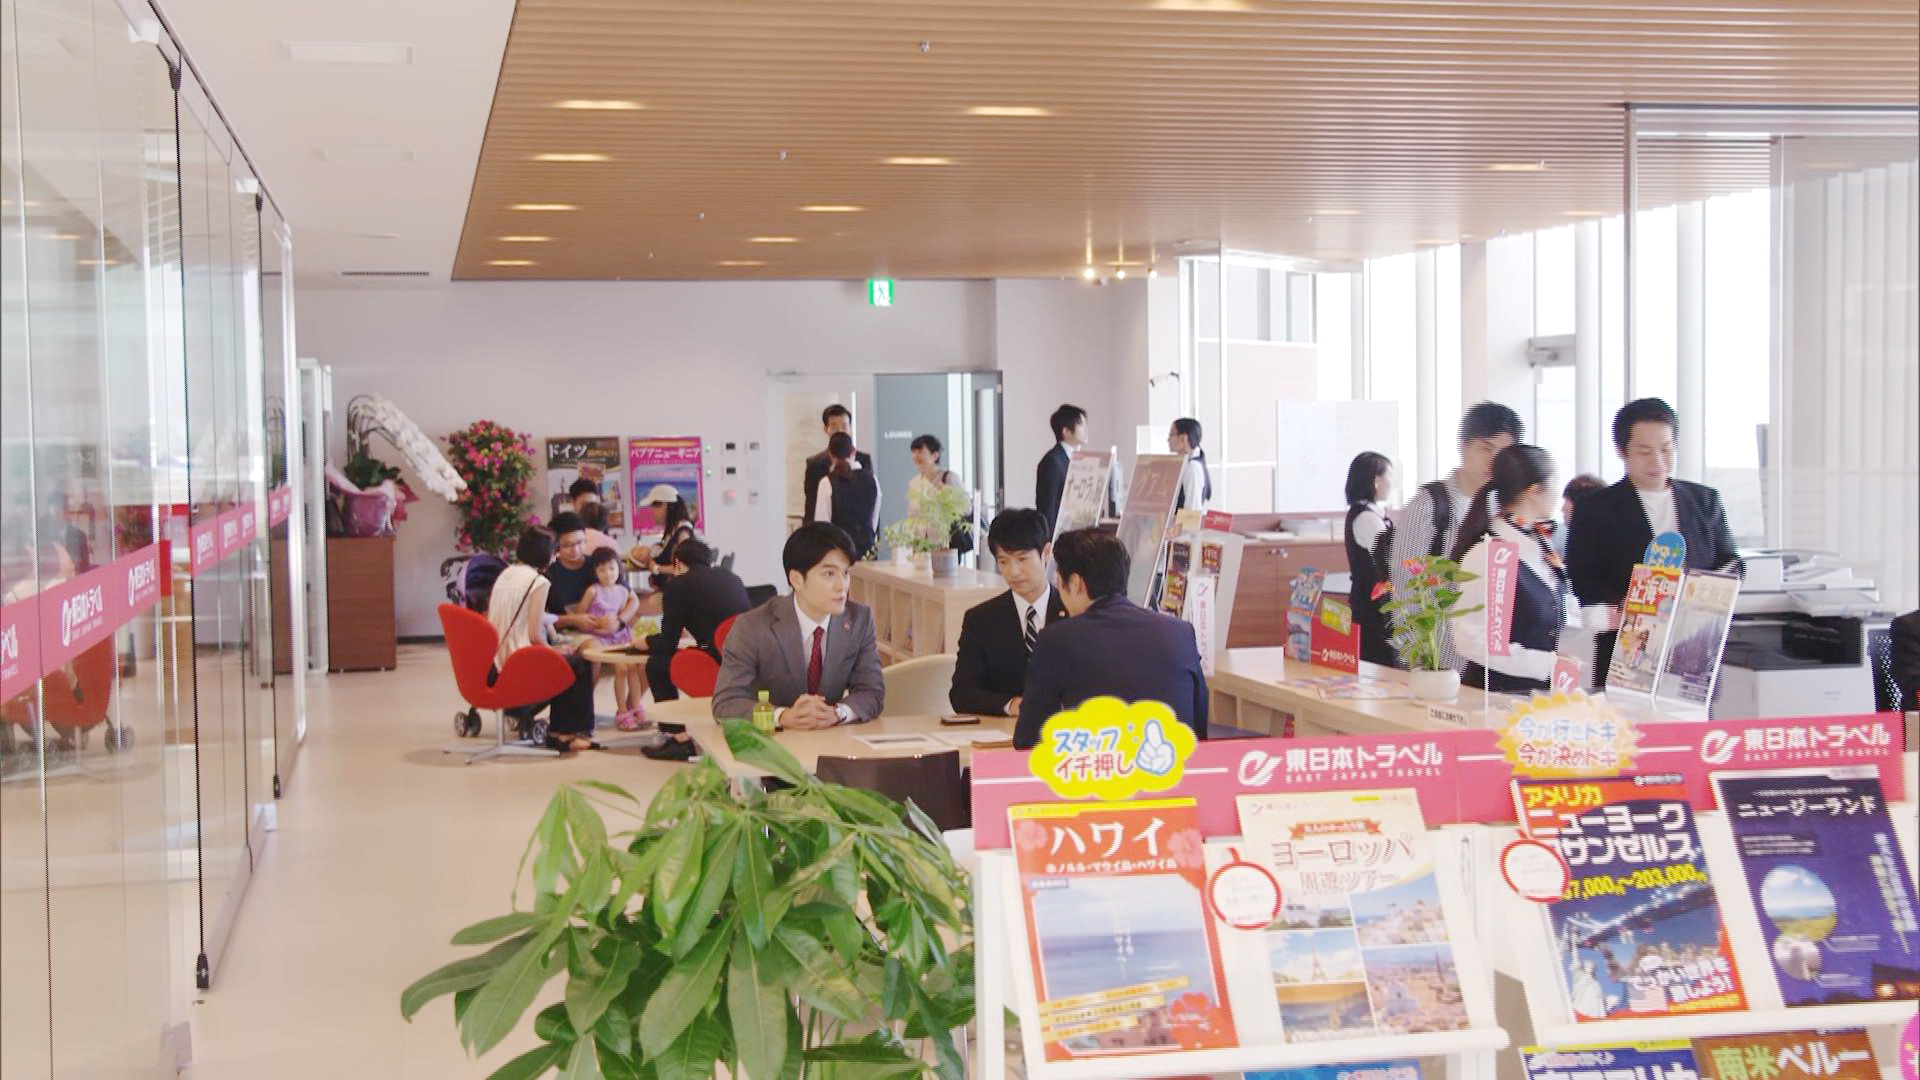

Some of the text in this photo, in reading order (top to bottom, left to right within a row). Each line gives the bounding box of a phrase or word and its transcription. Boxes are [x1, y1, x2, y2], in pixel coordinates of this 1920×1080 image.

[884, 430, 913, 440] LOUNGE
[549, 443, 587, 460] ドイツ
[71, 583, 104, 625] 東日本トラベル
[1494, 567, 1508, 652] 東日本トラベル
[1055, 728, 1120, 754] スタッフ
[1743, 723, 1891, 752] 東日本トラベル
[1056, 752, 1134, 780] イチ押し
[1285, 742, 1443, 772] 東日本トラベル
[1743, 747, 1890, 762] EAST JAPAN TRAVEL
[1285, 767, 1442, 784] EAST JAPAN TRAVEL
[1522, 785, 1604, 809] アメリカ
[1737, 795, 1877, 819] ニュージーランド
[1528, 802, 1687, 837] ニューヨーク
[1050, 817, 1166, 858] ハワイ
[1271, 831, 1415, 869] ヨーロッパ
[1547, 830, 1695, 867] サンゼルス
[1299, 868, 1401, 893] 周遊ツアー
[1711, 1041, 1871, 1080] 南米ペルー
